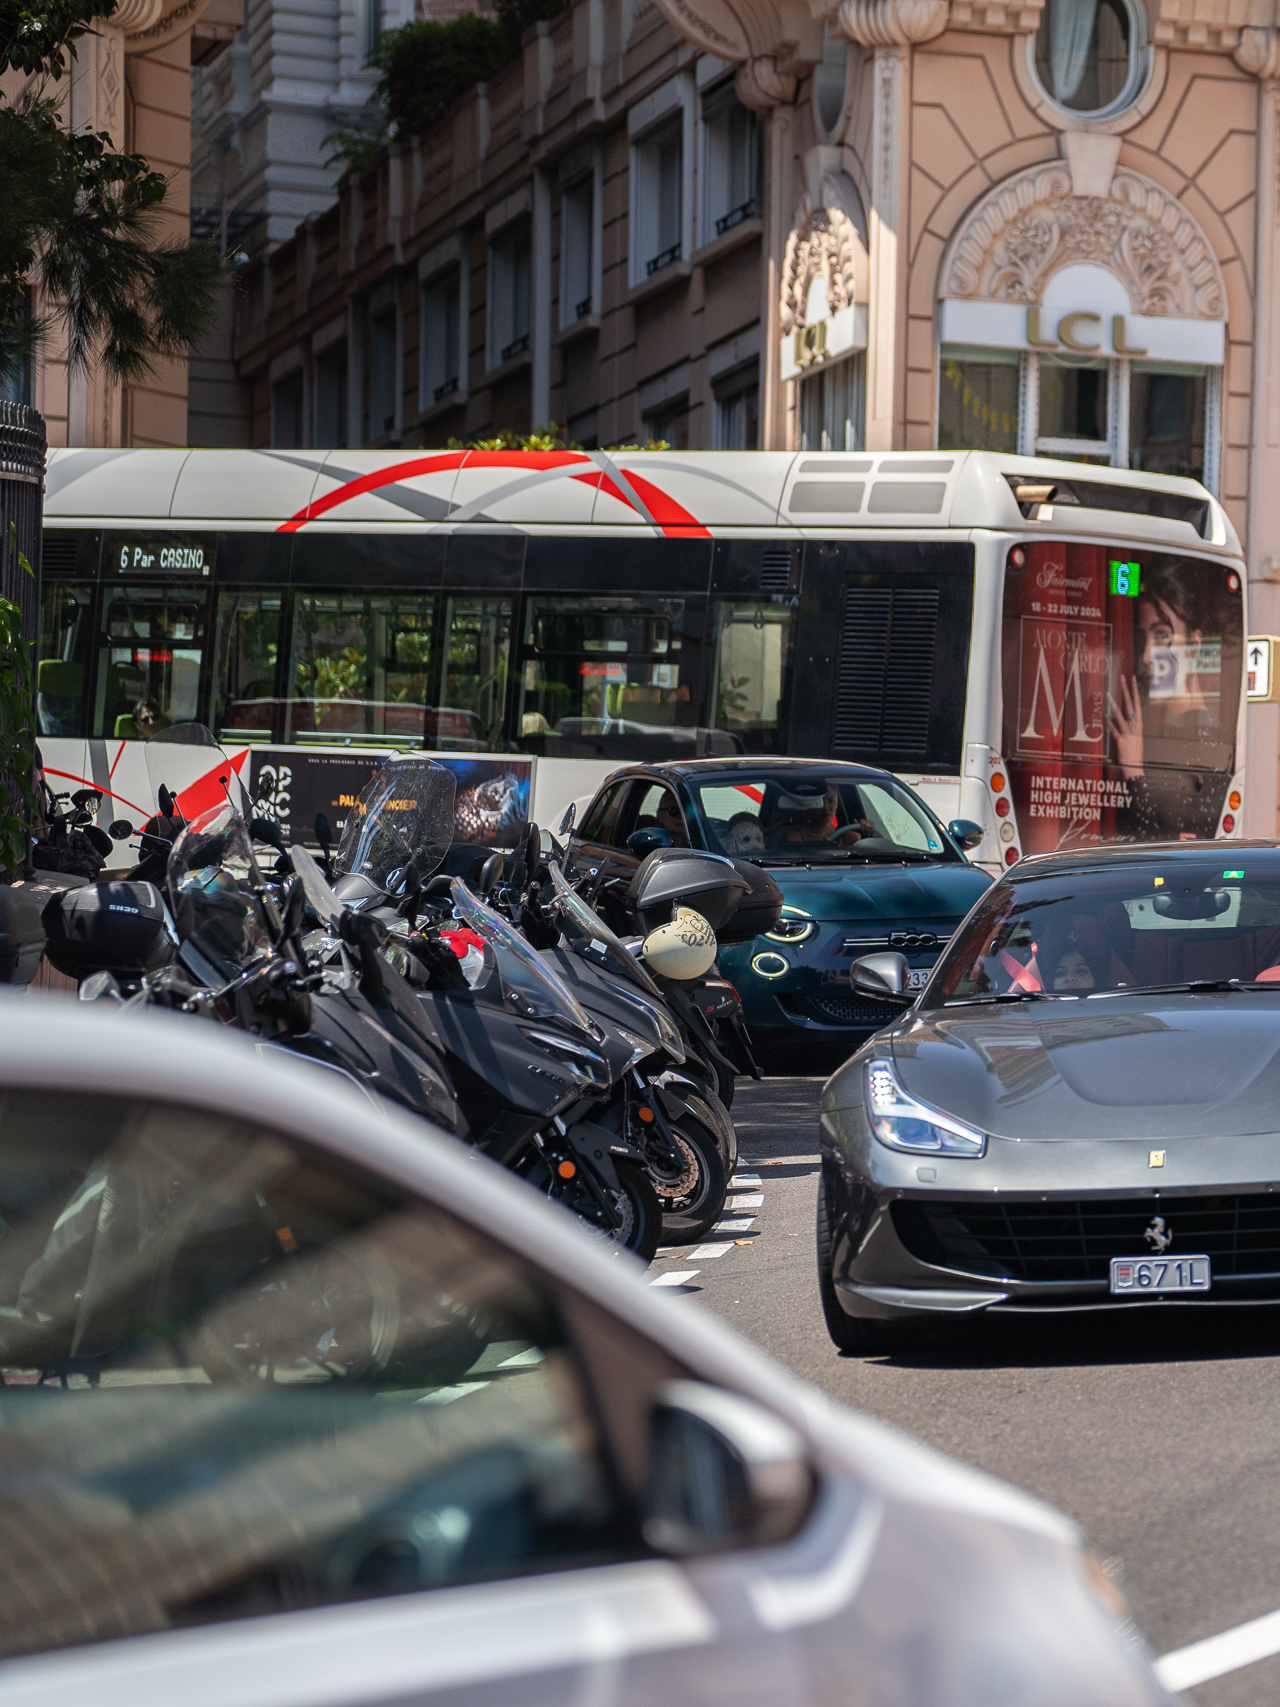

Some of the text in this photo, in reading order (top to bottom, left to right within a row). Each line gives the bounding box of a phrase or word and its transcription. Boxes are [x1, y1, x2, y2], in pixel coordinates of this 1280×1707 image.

[1026, 306, 1148, 355] LCL
[120, 546, 204, 569] 6 Par CASINO
[1036, 561, 1093, 592] Fairmont
[1116, 563, 1130, 595] 6
[1031, 602, 1041, 612] 18
[1047, 604, 1058, 614] 22
[1059, 605, 1079, 616] JULY
[1080, 607, 1102, 618] 2024
[1033, 627, 1087, 651] MONTE
[1030, 775, 1130, 795] INTERNATIONAL
[1030, 789, 1133, 809] HIGH JEWELLERY
[1029, 804, 1101, 821] EXHIBITION
[890, 932, 937, 947] 500
[908, 972, 930, 987] 33
